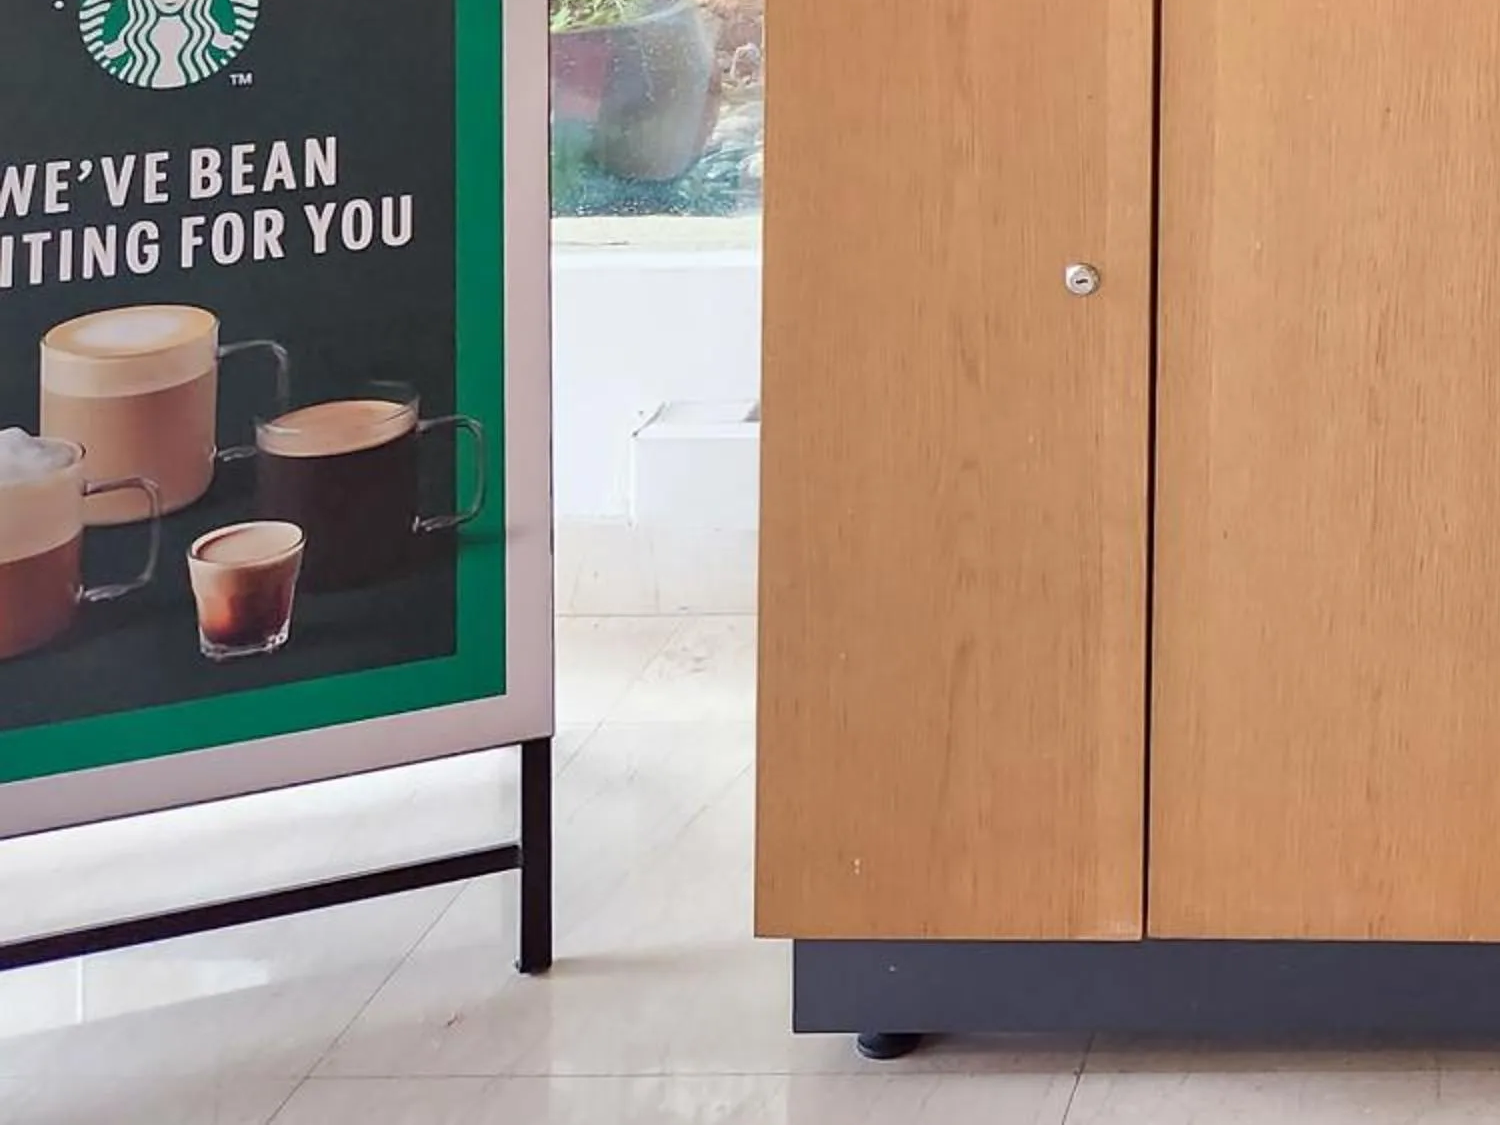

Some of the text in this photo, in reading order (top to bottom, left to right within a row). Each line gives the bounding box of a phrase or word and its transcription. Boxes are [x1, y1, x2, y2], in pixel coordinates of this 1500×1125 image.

[229, 73, 254, 85] TM
[188, 135, 339, 201] BEAN
[180, 208, 285, 269] FOR
[303, 194, 414, 254] YOU
